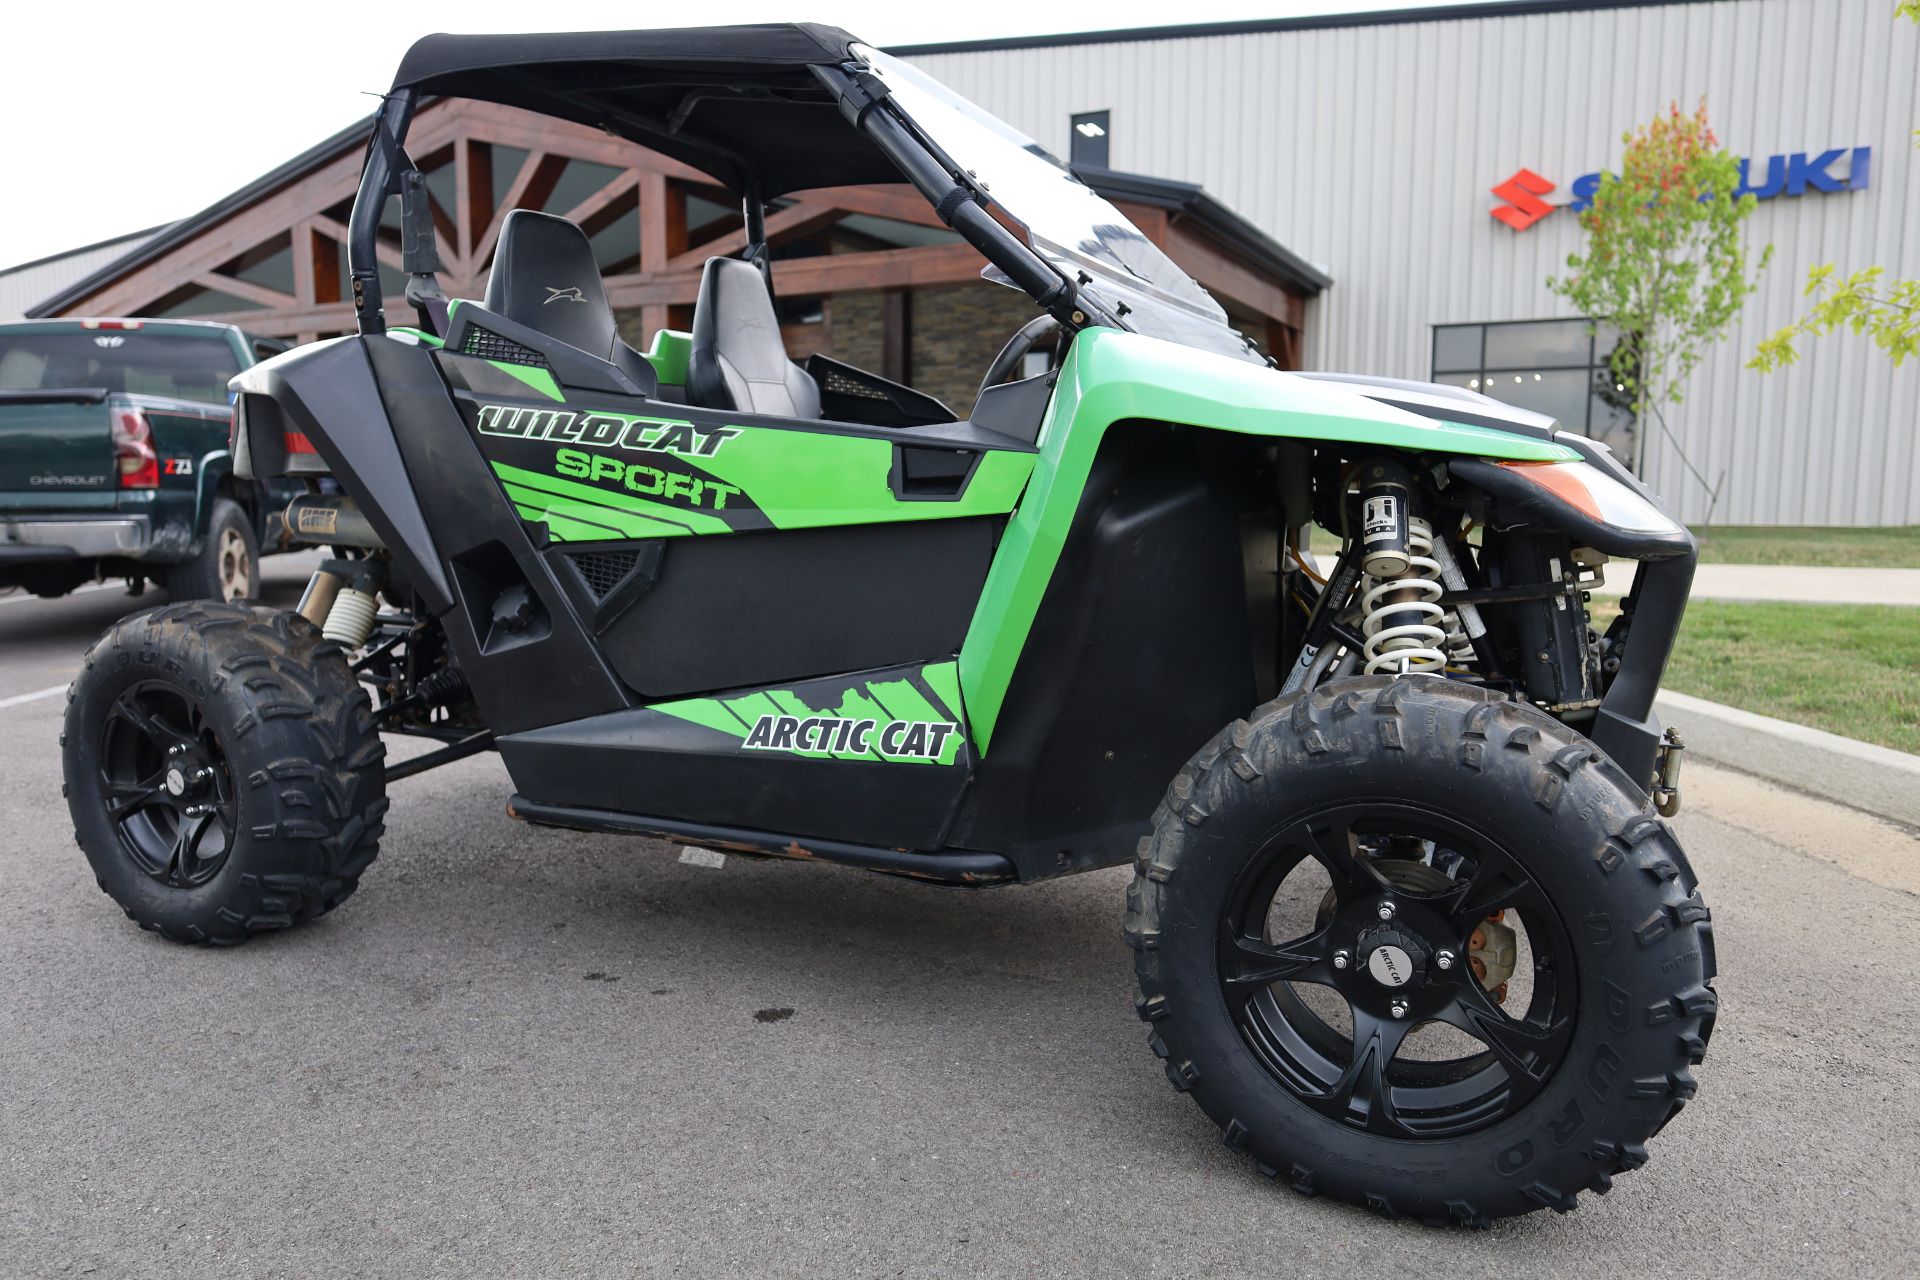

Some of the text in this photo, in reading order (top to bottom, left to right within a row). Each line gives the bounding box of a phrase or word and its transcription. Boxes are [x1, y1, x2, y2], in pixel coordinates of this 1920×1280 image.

[1570, 146, 1872, 213] SUKI
[478, 405, 745, 457] WILDCAT
[29, 475, 107, 485] CHEVROLET
[164, 458, 193, 475] Z71
[555, 447, 741, 510] SPORT
[741, 715, 958, 760] ARCTIC CAT
[1379, 948, 1403, 984] ARCTIC CAT
[1493, 976, 1634, 1176] DURO
